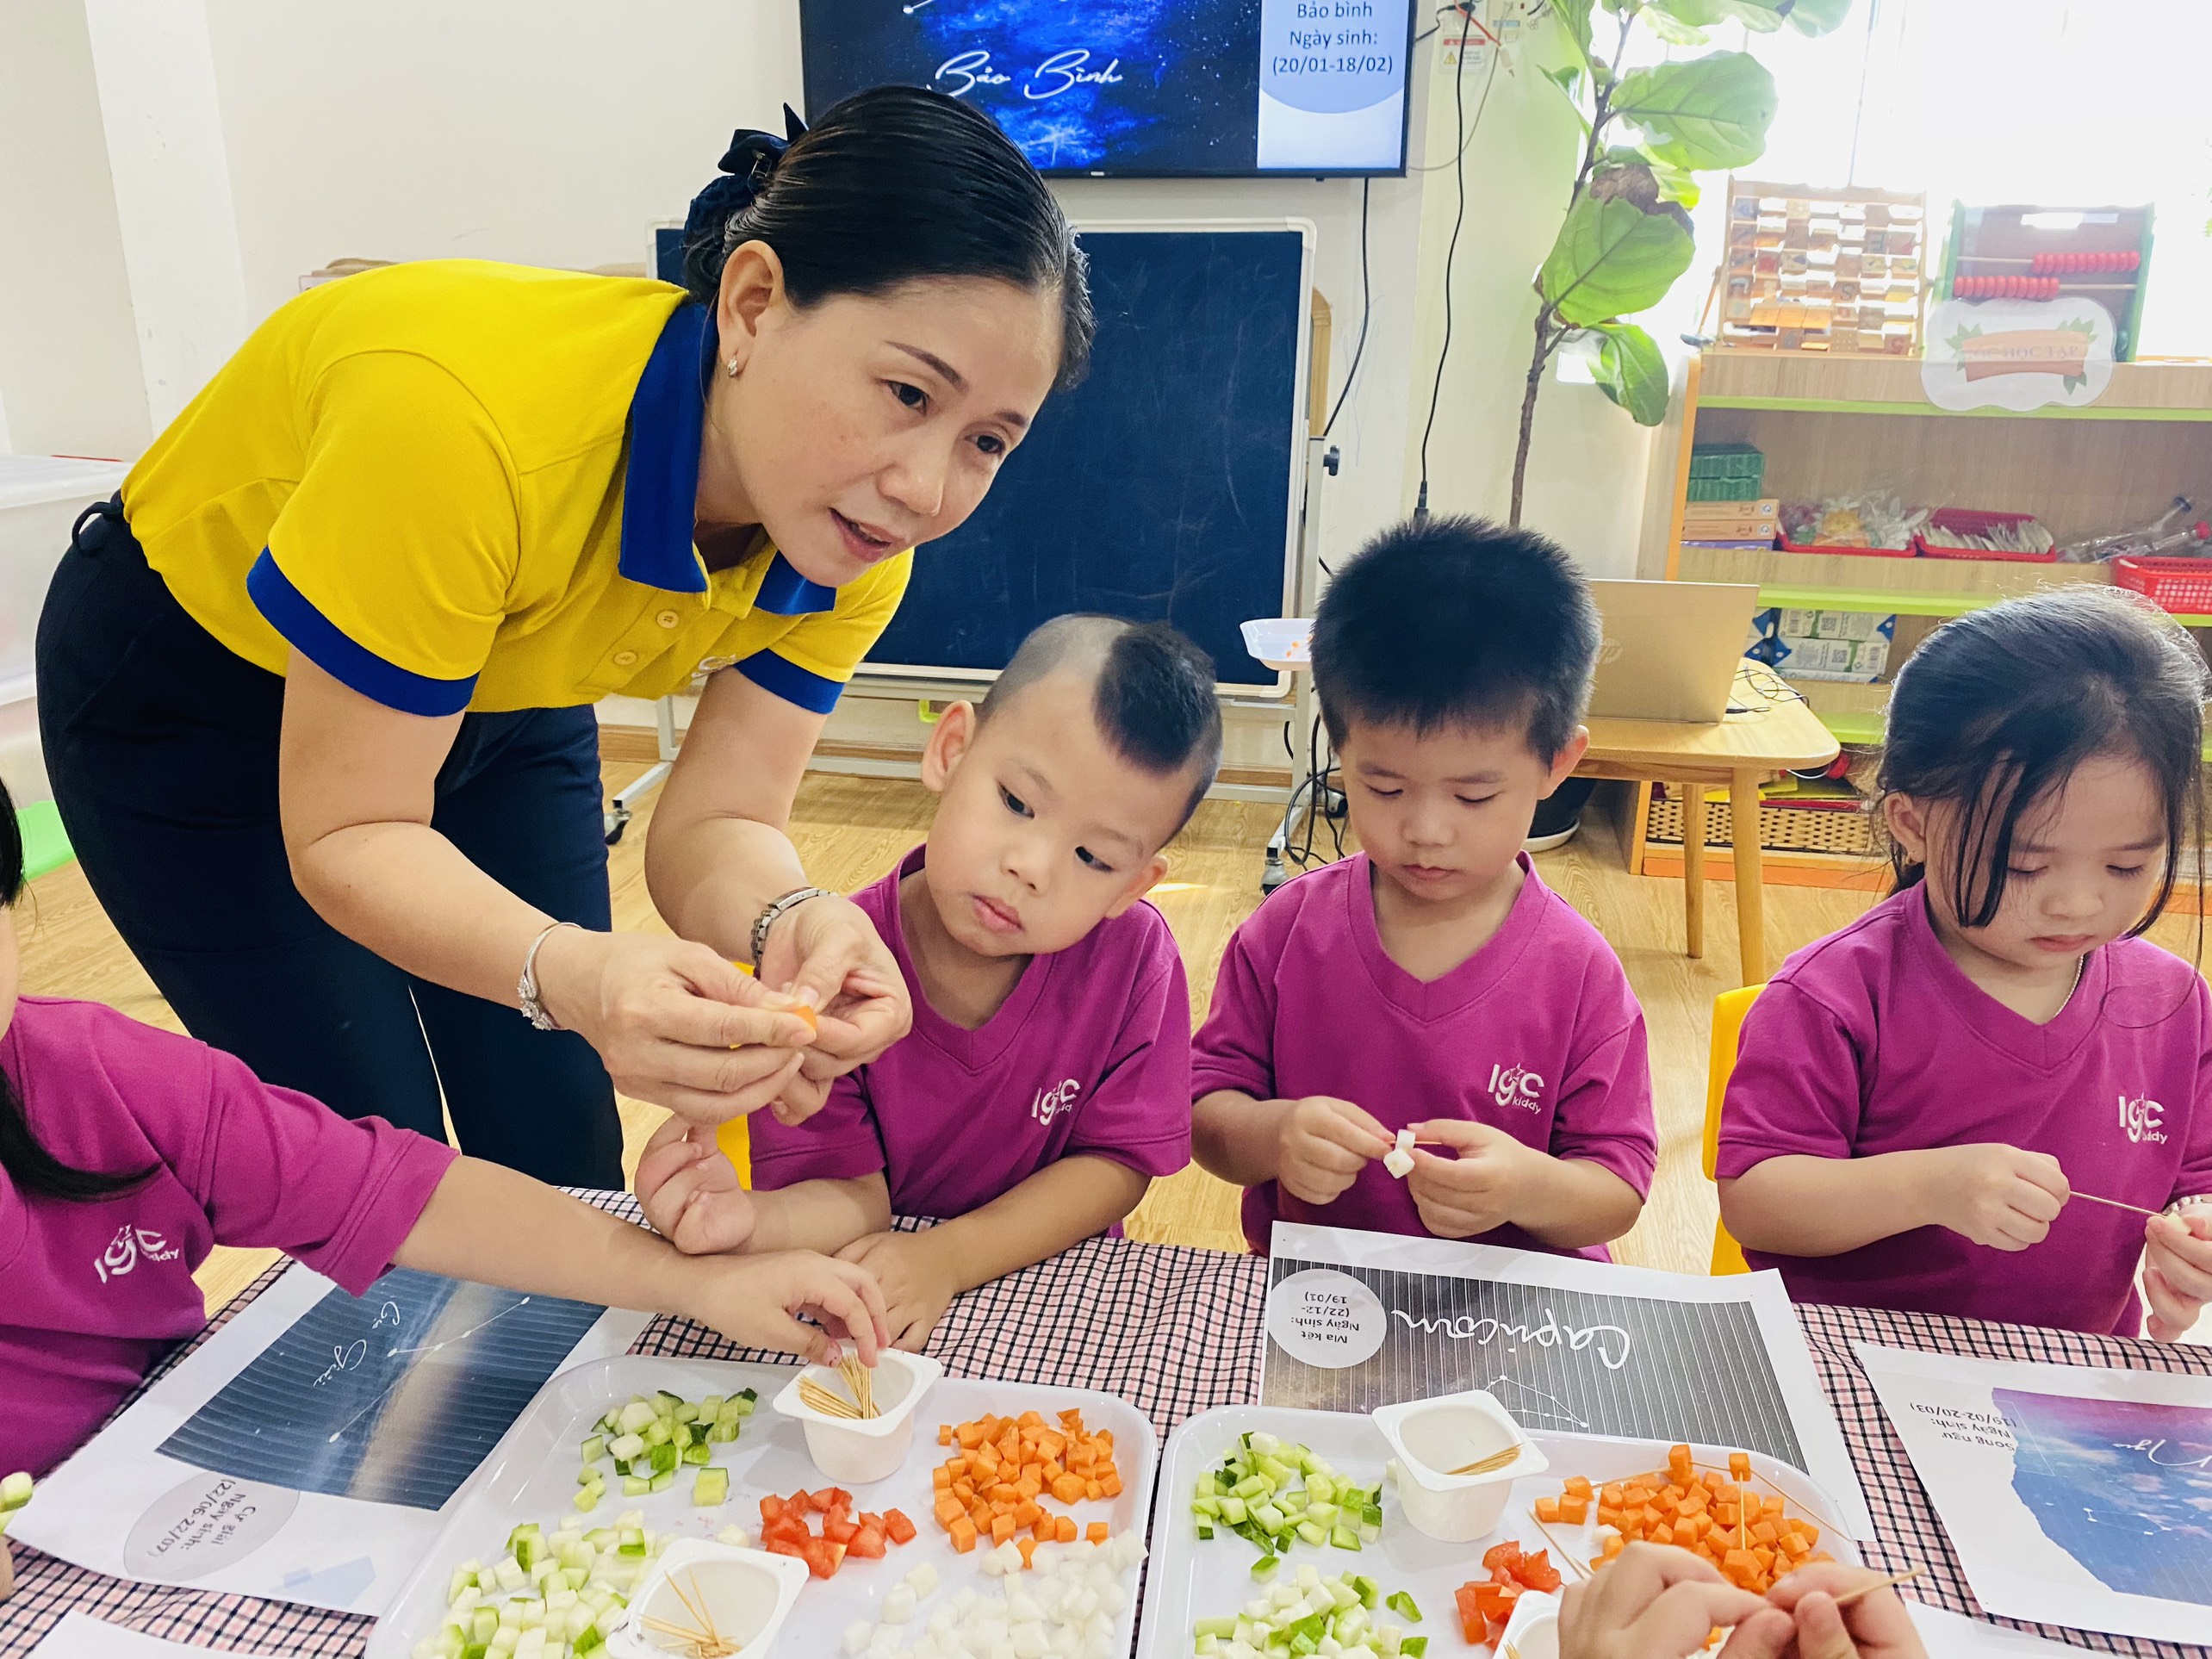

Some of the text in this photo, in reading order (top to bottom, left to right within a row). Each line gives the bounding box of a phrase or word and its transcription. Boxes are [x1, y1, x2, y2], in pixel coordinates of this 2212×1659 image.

[1297, 0, 1372, 18] Bảo bình
[1289, 29, 1377, 49] Ngày sinh:
[1273, 55, 1393, 76] (20/01-18/02)
[1512, 1096, 1542, 1115] kiddy
[1304, 1291, 1348, 1304] 19/01)
[1301, 1306, 1350, 1317] (22/12-
[1290, 1317, 1359, 1332] Ngày sinh:
[1326, 1333, 1348, 1344] Ma
[1390, 1308, 1631, 1370] Capricorn
[1910, 1402, 2017, 1428] (19/02-20/03)
[1930, 1418, 2011, 1438] Ngày sinh:
[1975, 1436, 2016, 1451] Song
[146, 1479, 237, 1557] (22/06-22/07)
[180, 1522, 214, 1550] sinh:
